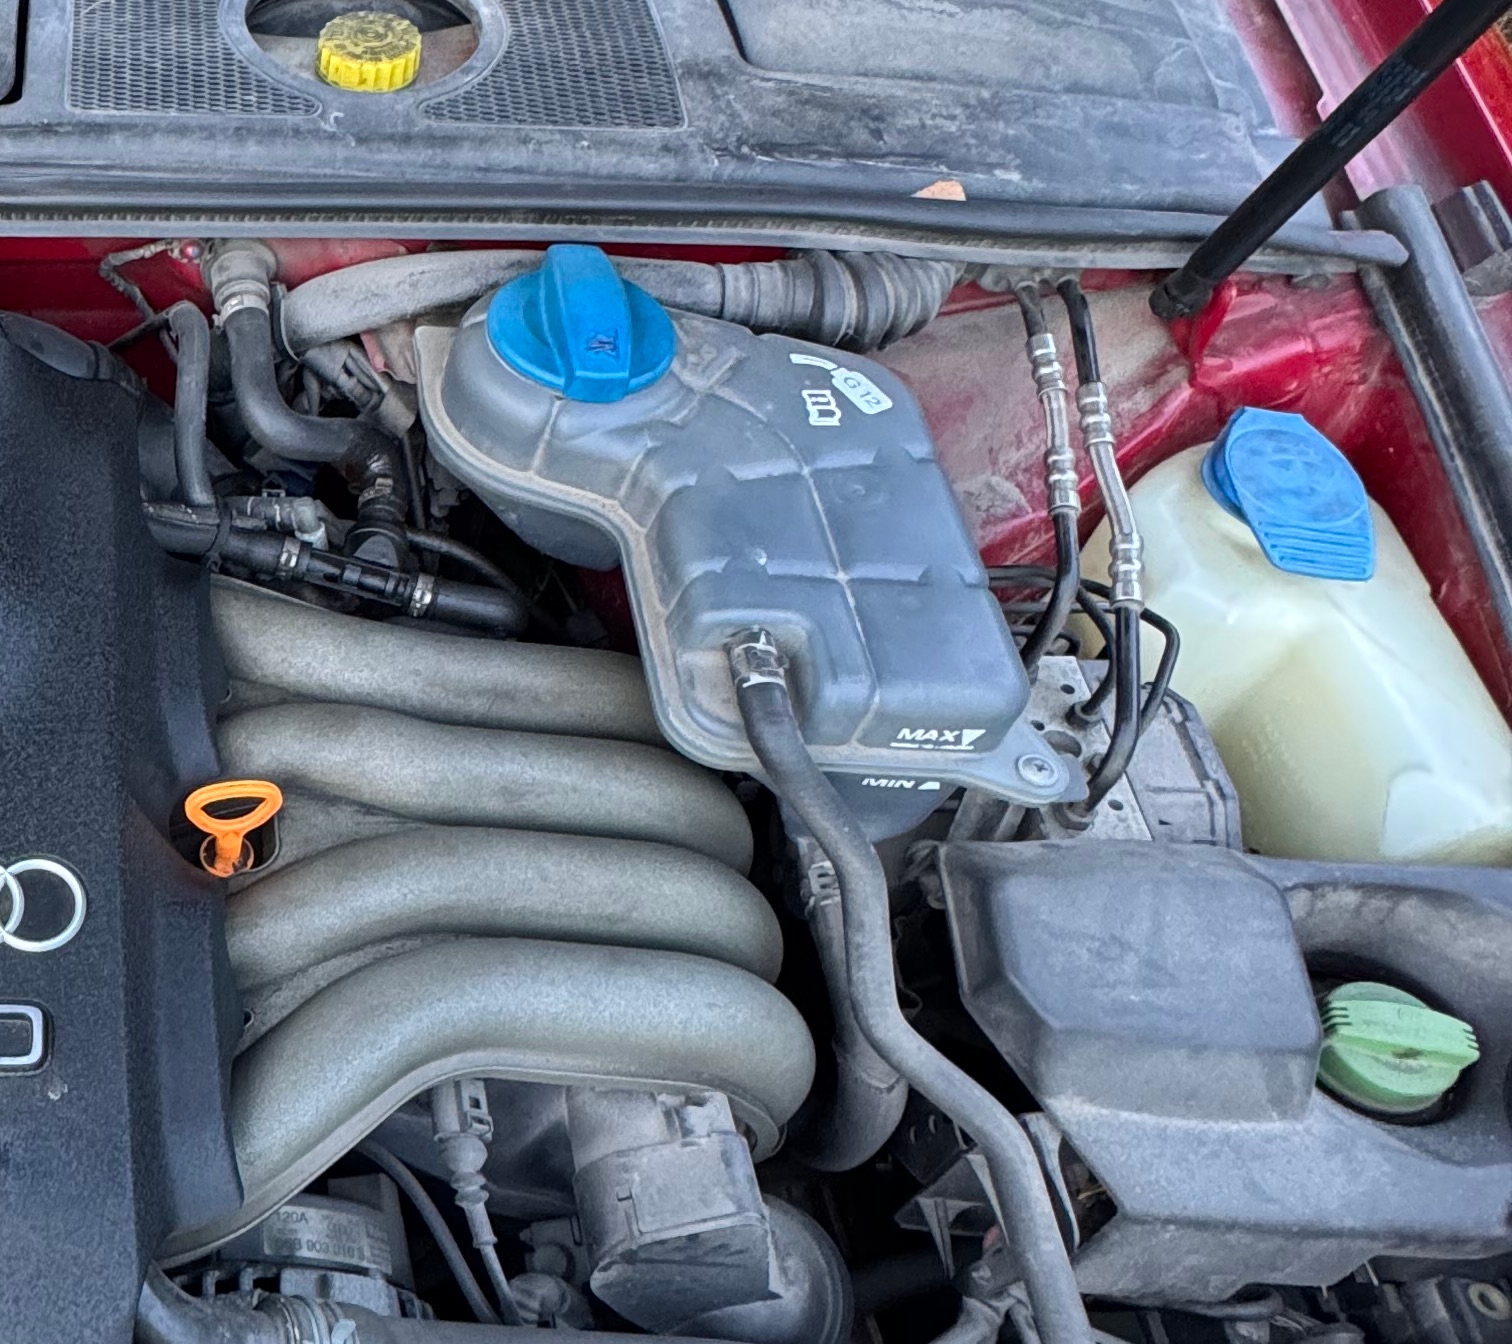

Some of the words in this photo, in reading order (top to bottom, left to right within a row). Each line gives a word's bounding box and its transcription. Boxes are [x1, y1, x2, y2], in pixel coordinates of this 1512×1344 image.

[843, 376, 861, 389] G
[859, 391, 881, 409] 12
[896, 727, 961, 743] MAX
[861, 777, 916, 790] MIN
